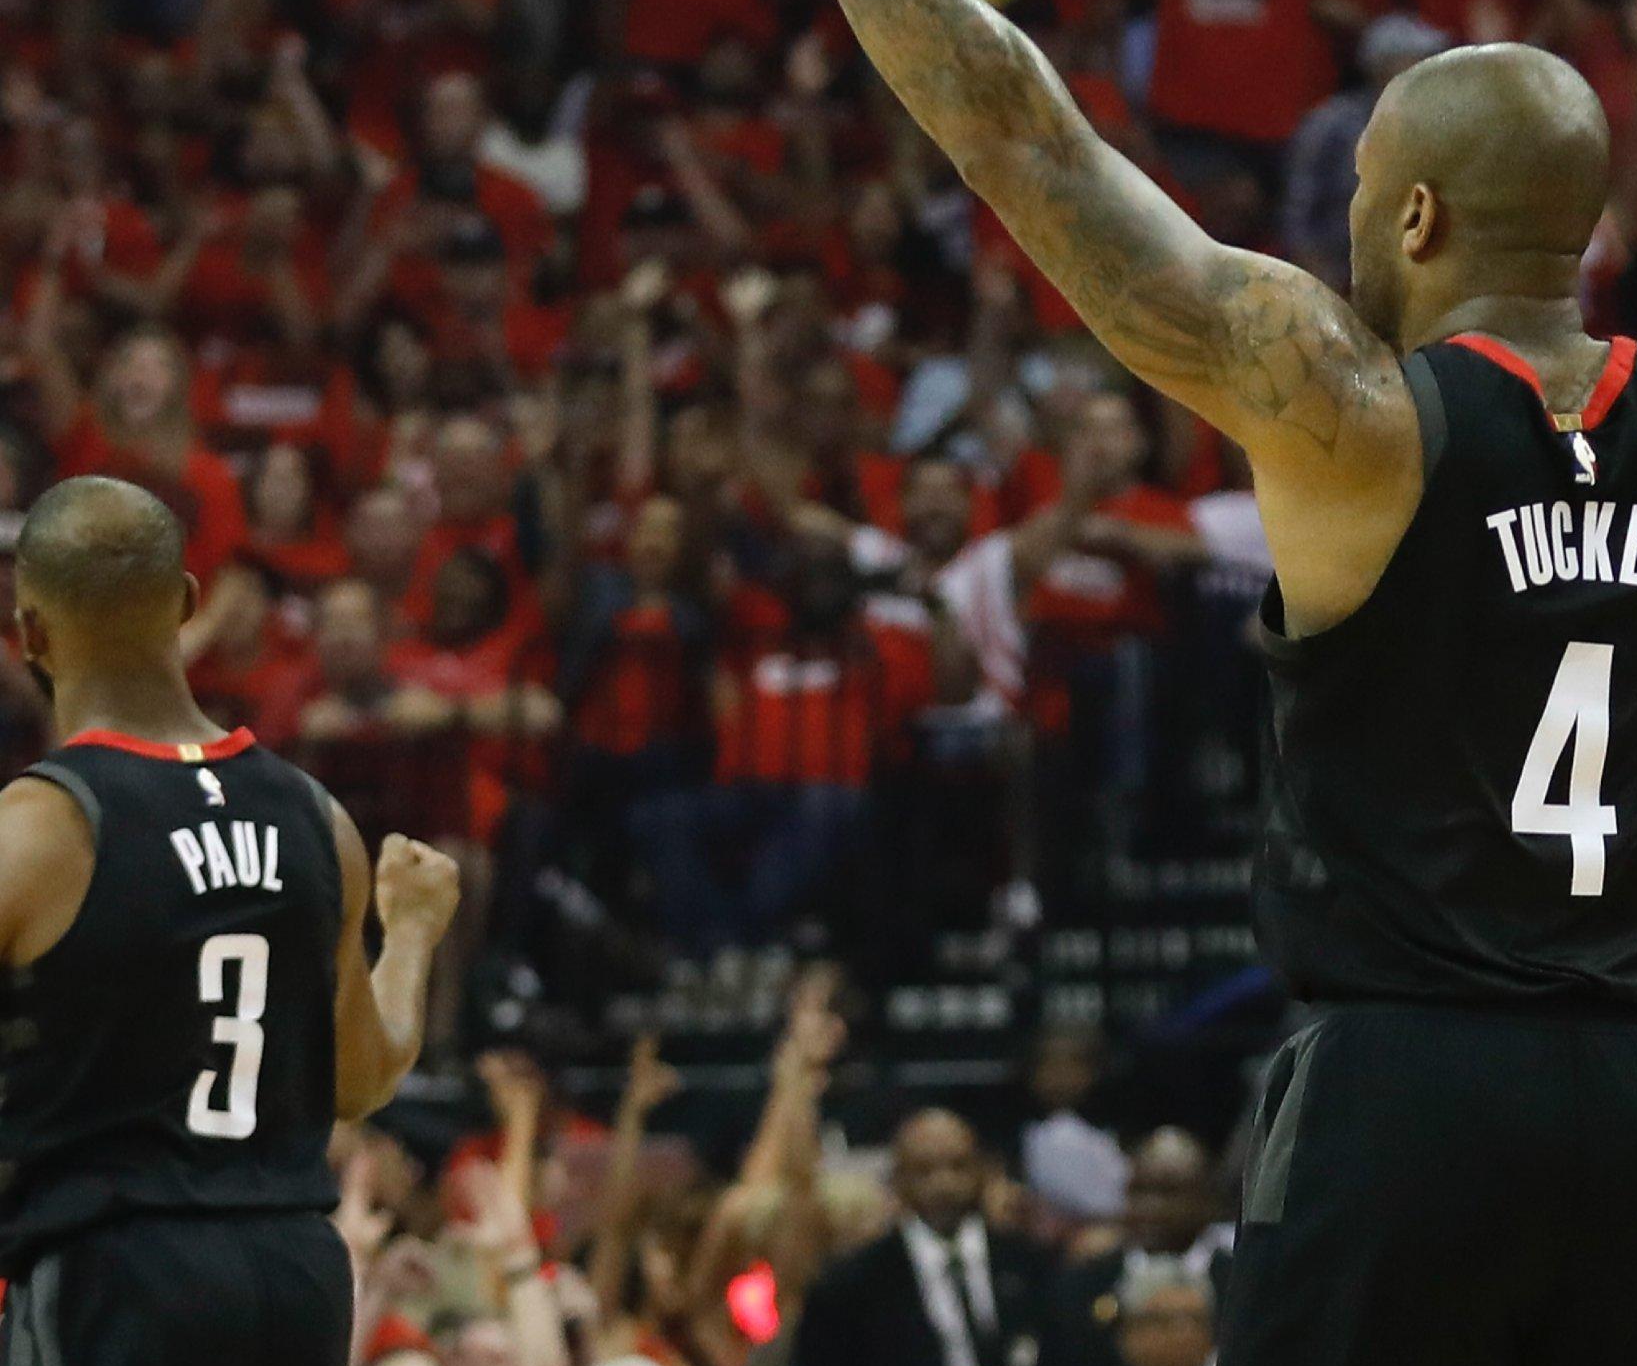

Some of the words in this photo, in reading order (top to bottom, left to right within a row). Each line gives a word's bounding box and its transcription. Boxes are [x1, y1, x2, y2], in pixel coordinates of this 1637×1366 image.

[169, 820, 283, 895] PAUL
[1511, 641, 1618, 896] 4
[186, 933, 270, 1140] 3
